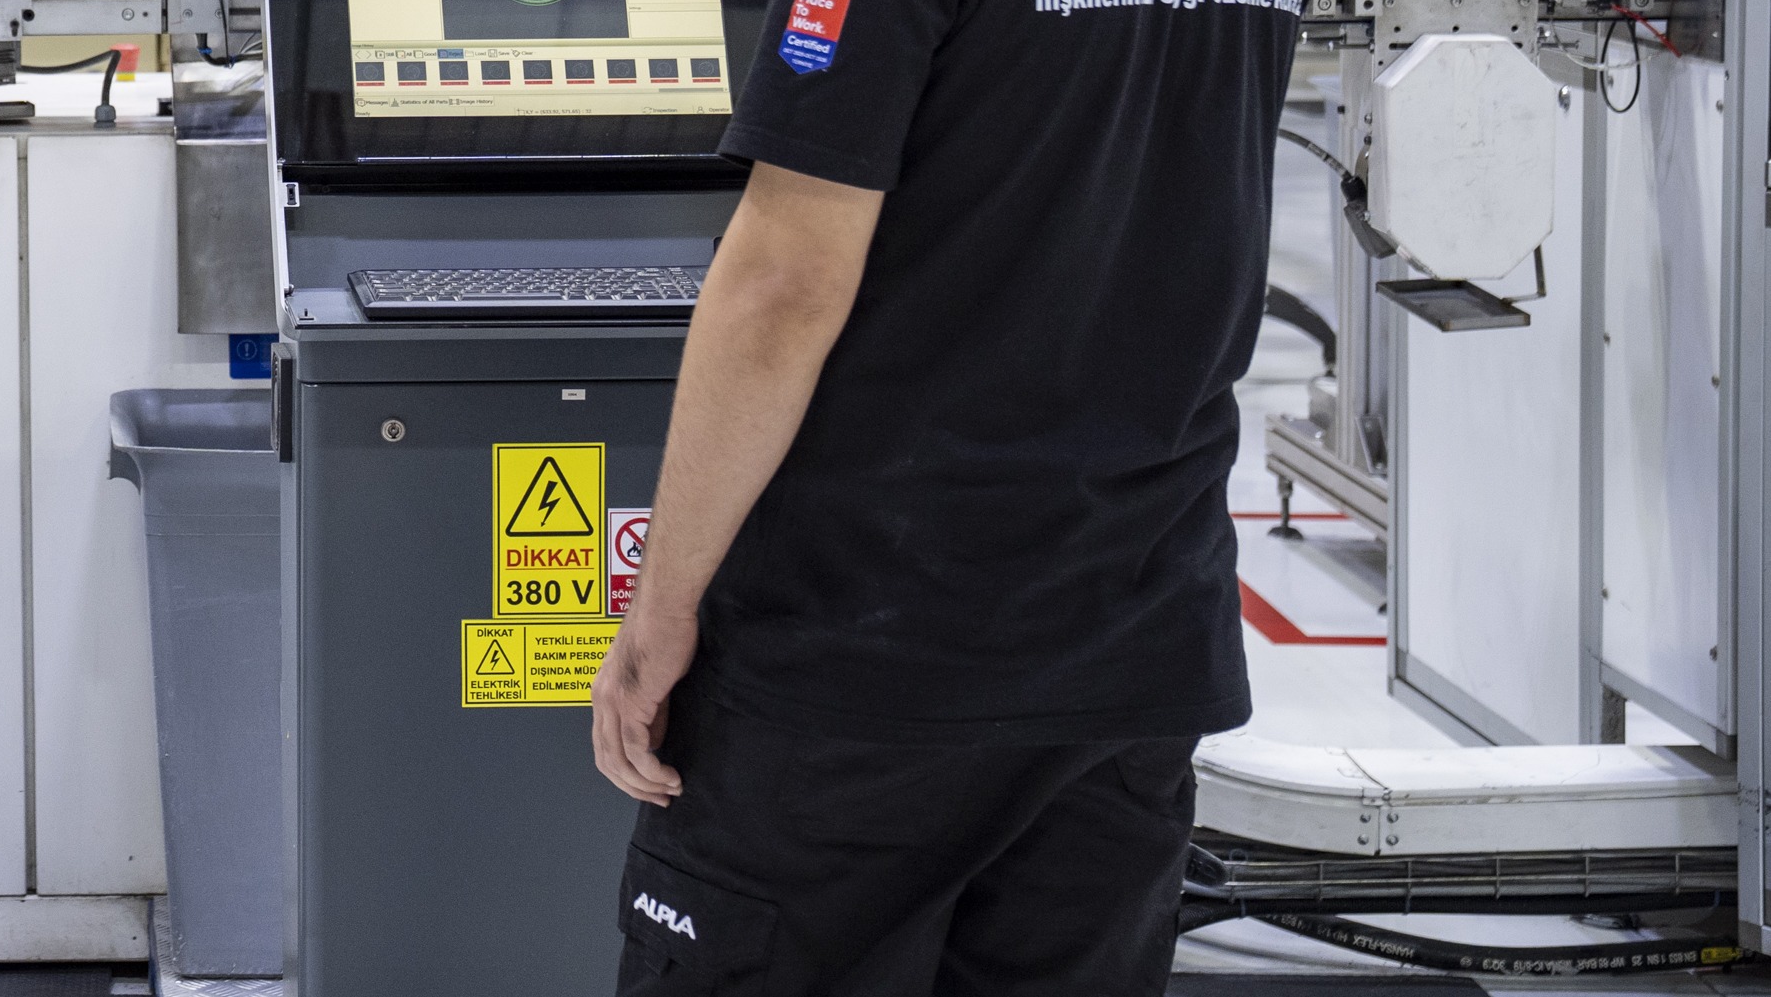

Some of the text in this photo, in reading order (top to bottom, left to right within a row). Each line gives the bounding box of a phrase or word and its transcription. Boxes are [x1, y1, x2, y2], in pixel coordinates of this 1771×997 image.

[796, 4, 809, 16] To
[787, 35, 830, 53] Certified
[506, 545, 594, 567] DİKKAT
[506, 579, 594, 605] 380 V
[477, 627, 514, 637] DİKKAT
[535, 635, 615, 645] YETKİLİ ELEKTR
[534, 651, 607, 660] BAKIM PERSO
[530, 667, 572, 677] DIŞINDA
[470, 678, 520, 688] ELEKTRİK
[532, 680, 592, 690] EDİLMESİYA
[470, 690, 522, 700] TEHLİKESİ
[633, 892, 696, 940] ALPLA
